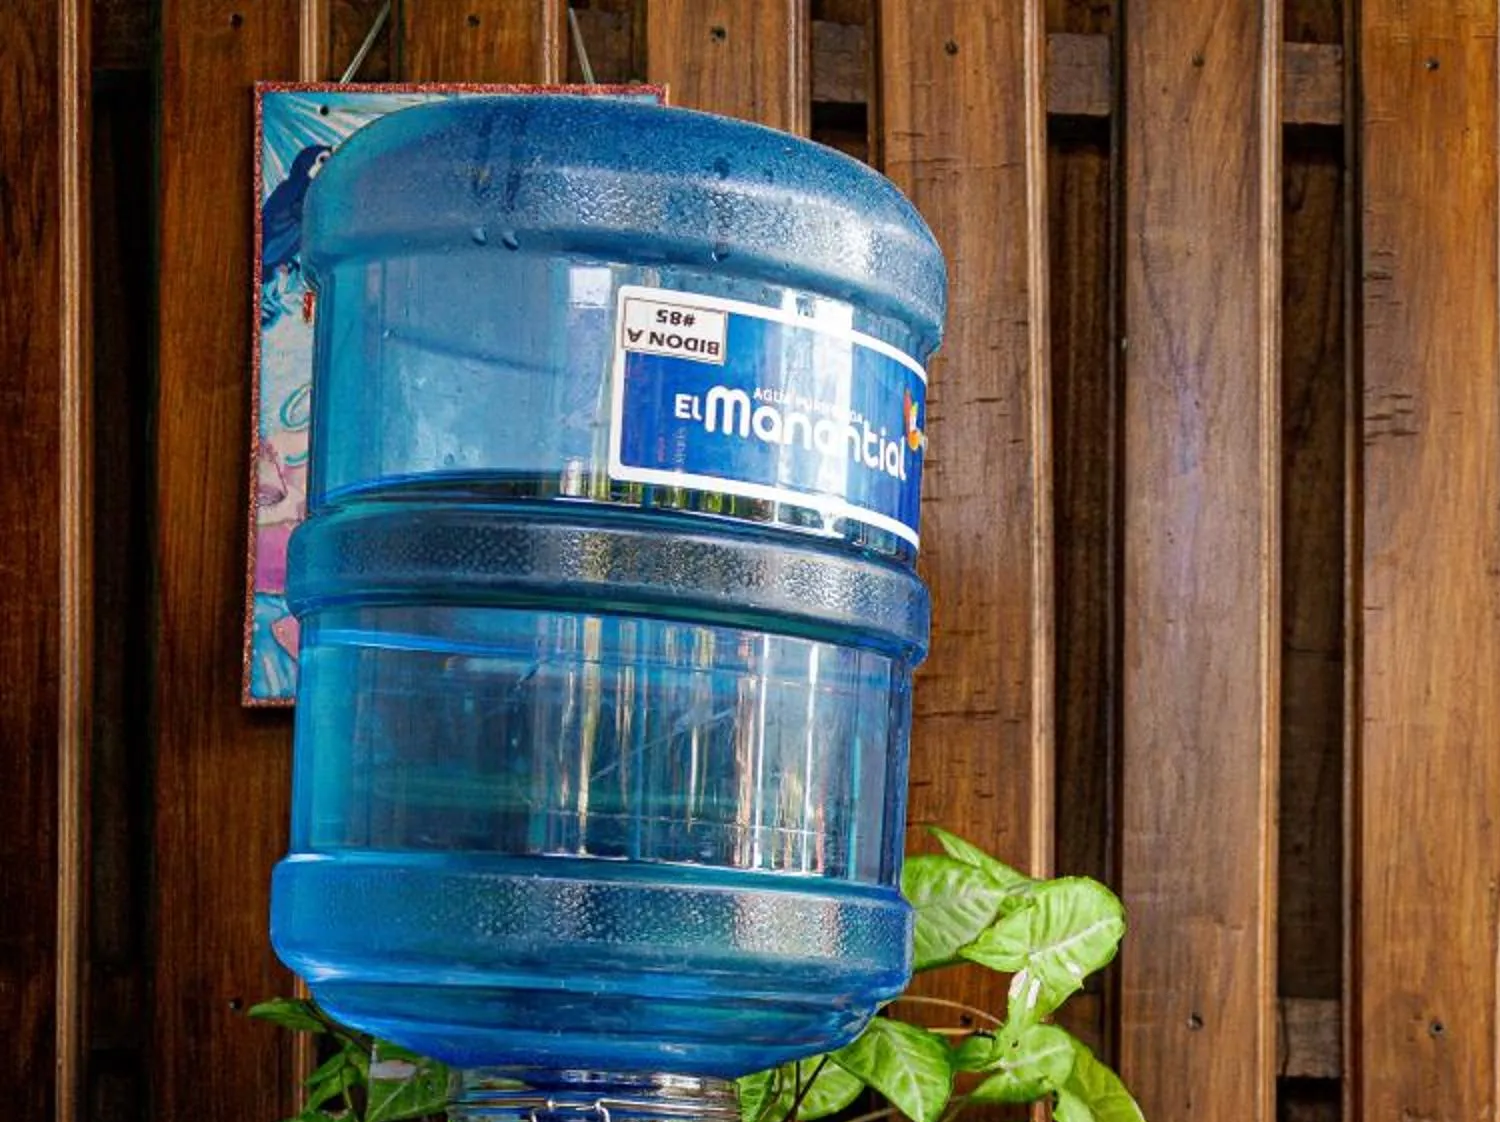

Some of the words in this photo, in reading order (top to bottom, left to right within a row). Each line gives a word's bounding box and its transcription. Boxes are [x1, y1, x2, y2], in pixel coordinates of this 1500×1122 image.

[656, 309, 695, 328] #85
[627, 328, 644, 343] A
[649, 331, 720, 356] BIDON
[704, 385, 906, 480] Manantial
